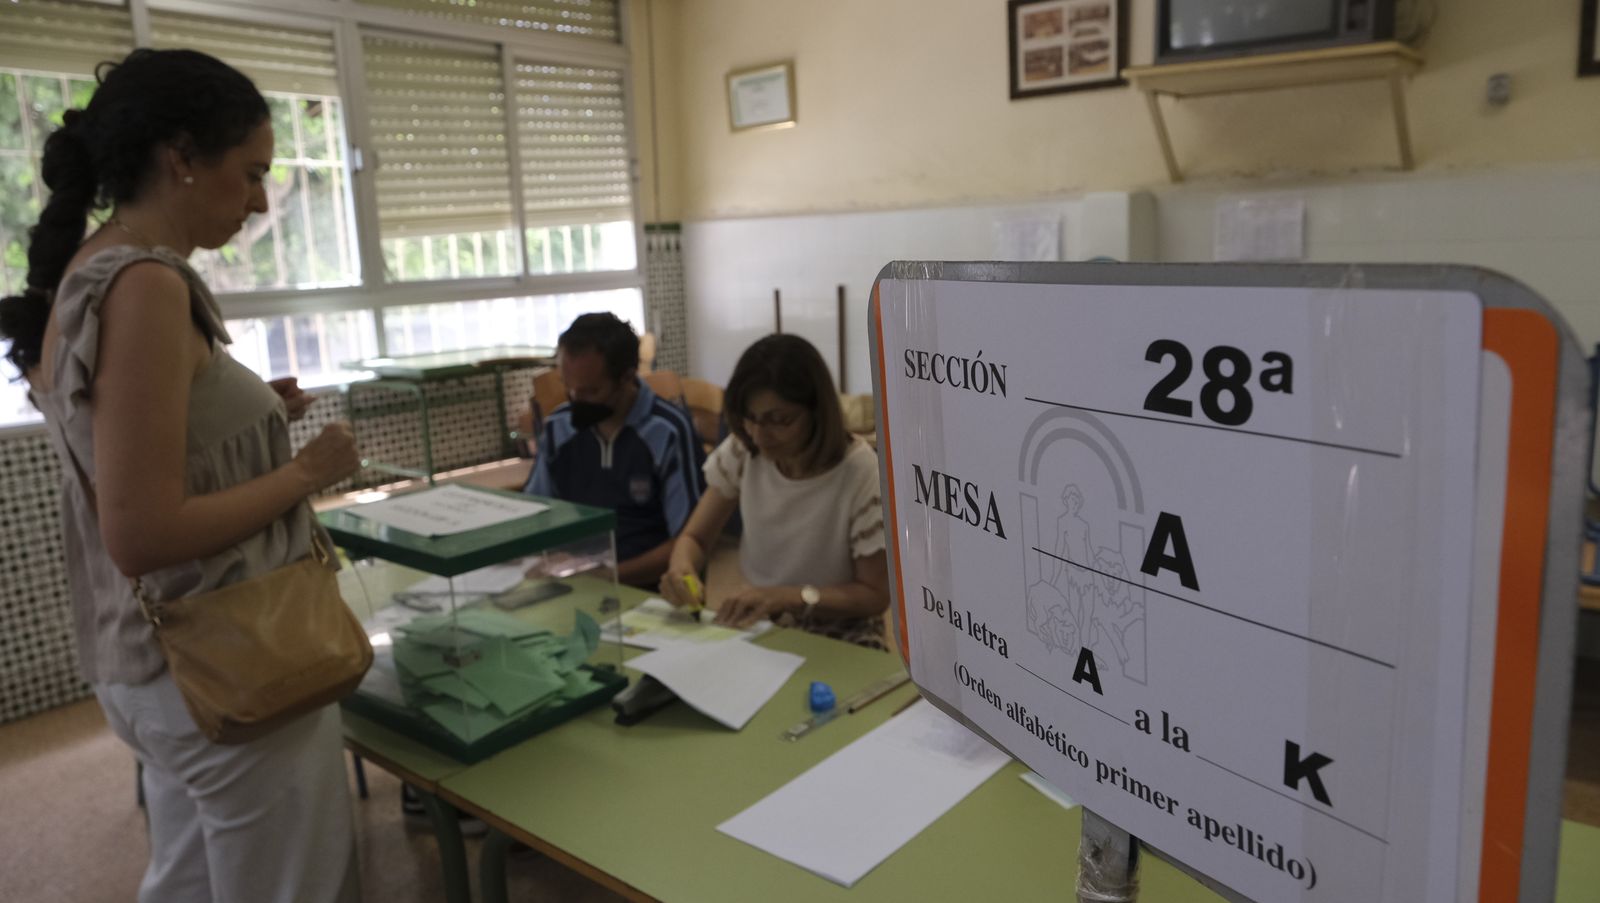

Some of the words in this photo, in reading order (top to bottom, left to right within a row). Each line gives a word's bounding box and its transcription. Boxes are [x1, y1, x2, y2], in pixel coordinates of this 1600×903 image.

[904, 349, 1008, 399] SECCIÓN
[914, 464, 1008, 540] MESA
[1140, 511, 1200, 593] A
[921, 586, 944, 619] De
[948, 599, 963, 631] la
[967, 612, 1009, 659] letra
[1072, 646, 1104, 696] A
[1134, 707, 1151, 734] a
[1162, 711, 1191, 753] la
[1283, 739, 1334, 808] K
[953, 661, 1002, 712] (Orden
[1006, 699, 1089, 769] alfabético
[1095, 757, 1180, 816] primer
[1187, 805, 1318, 891] apellido)
